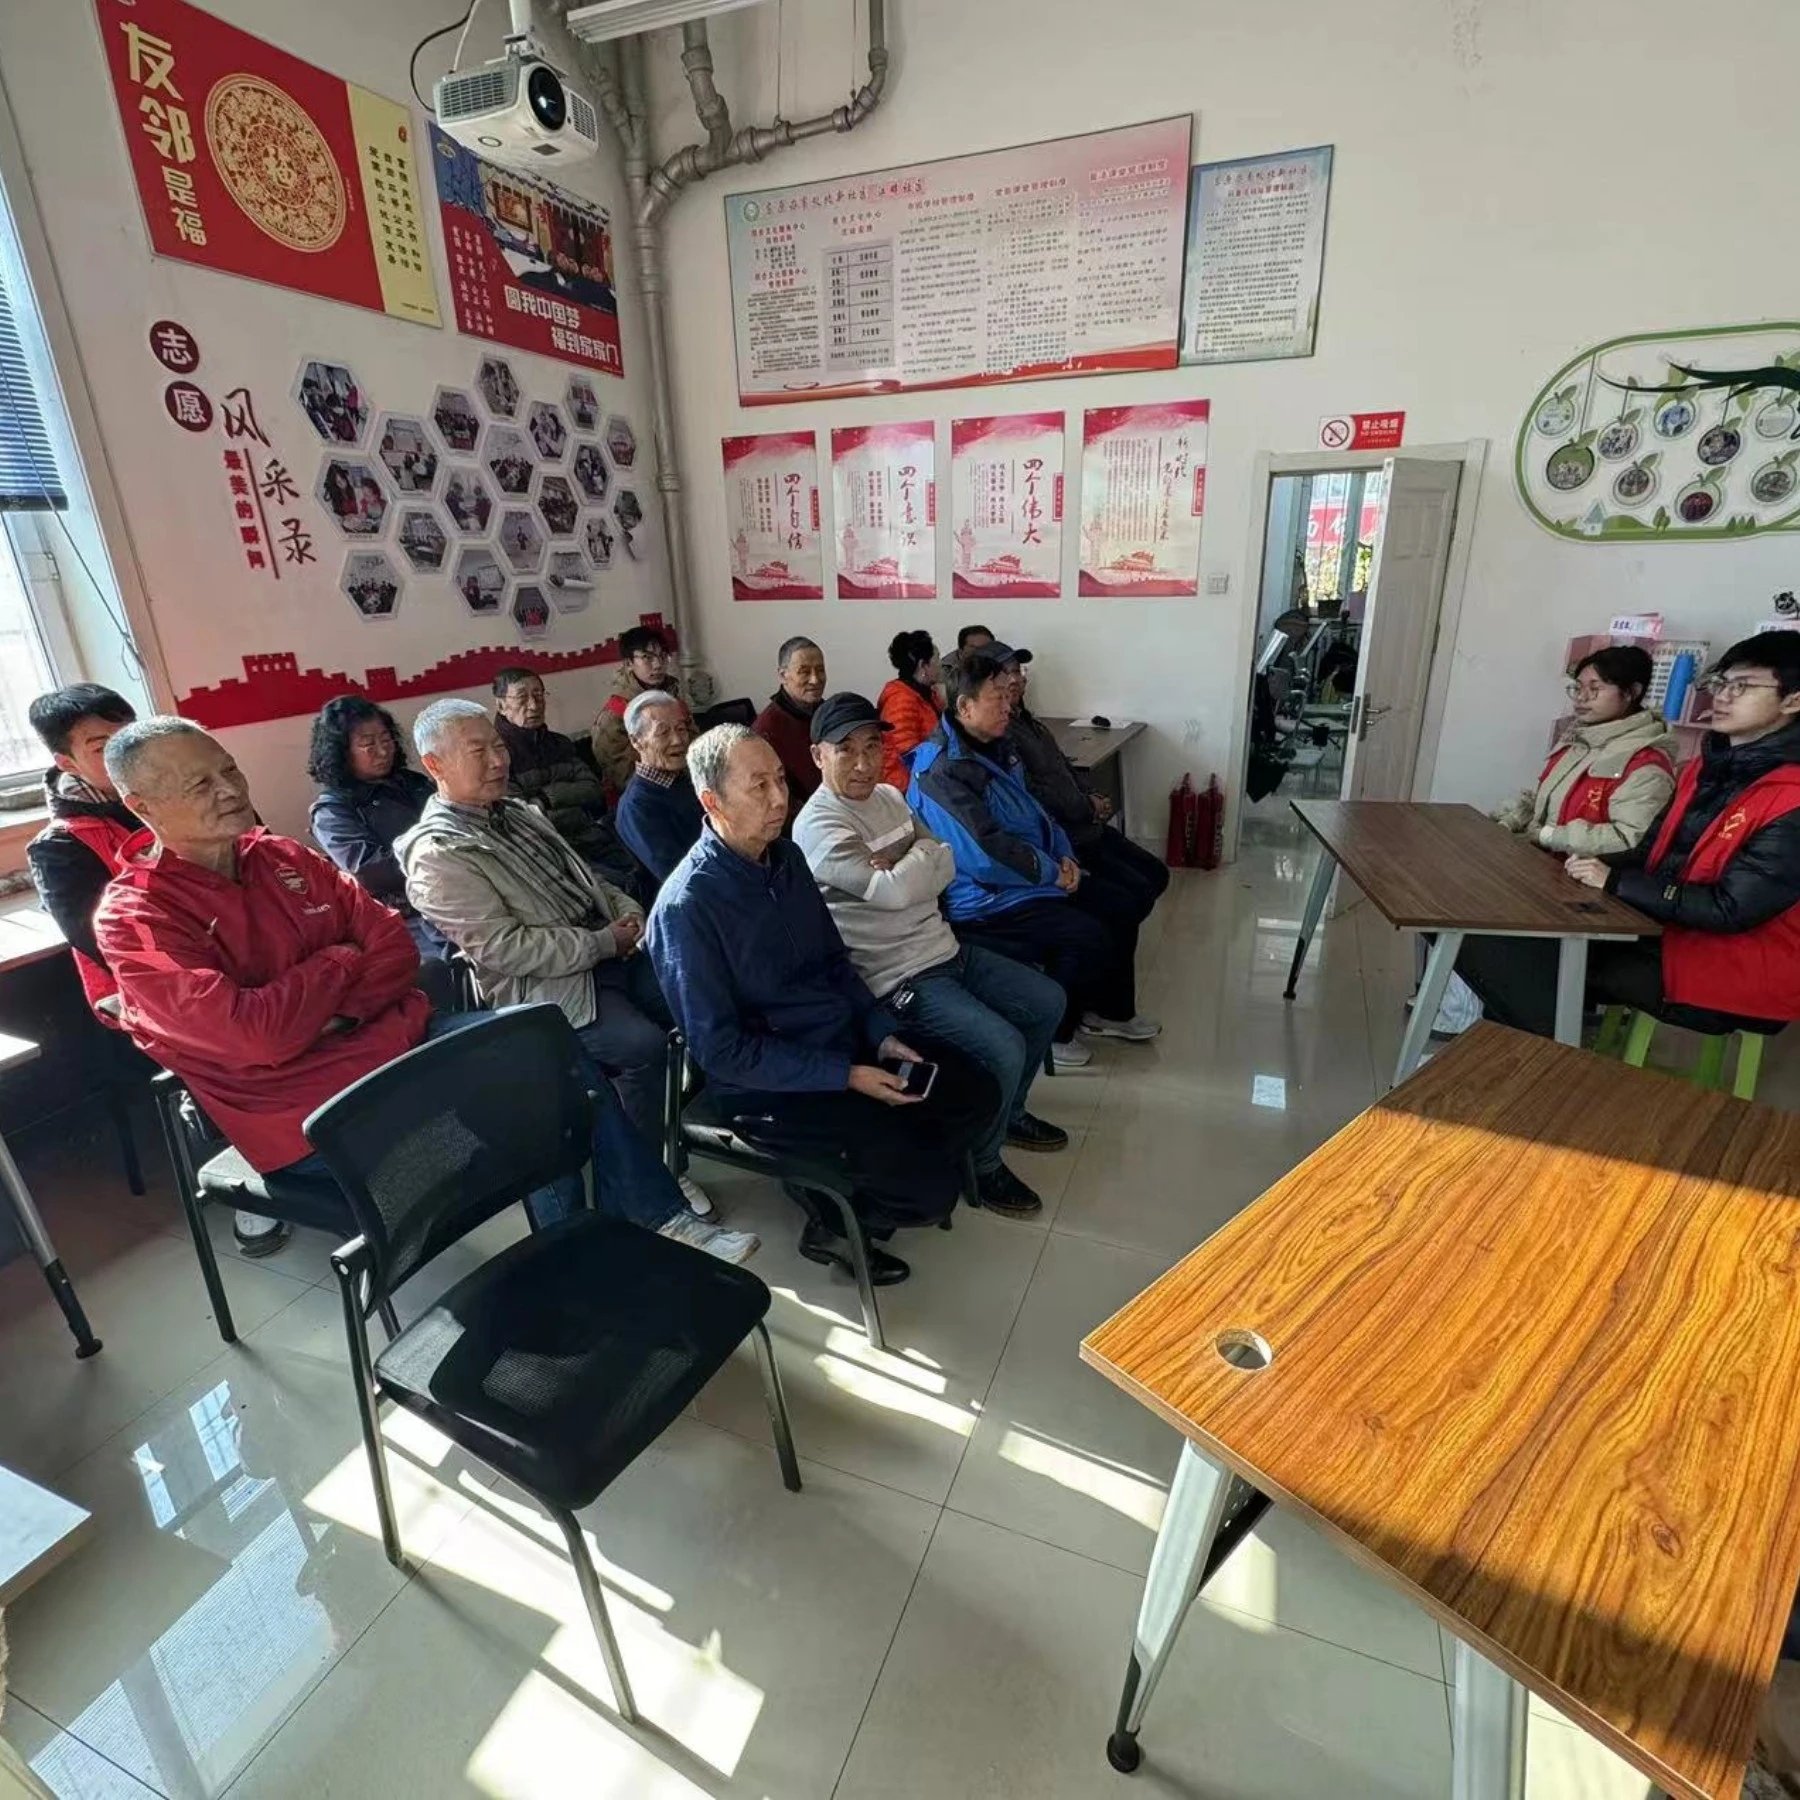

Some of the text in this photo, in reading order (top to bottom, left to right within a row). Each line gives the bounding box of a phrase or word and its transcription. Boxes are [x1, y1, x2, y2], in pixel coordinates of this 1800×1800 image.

[119, 21, 207, 246] 友邻是福
[503, 284, 581, 329] 圆我中国梦
[551, 325, 620, 366] 福到家家门
[156, 326, 317, 566] 志愿 风采录
[1022, 458, 1044, 545] 四个伟大
